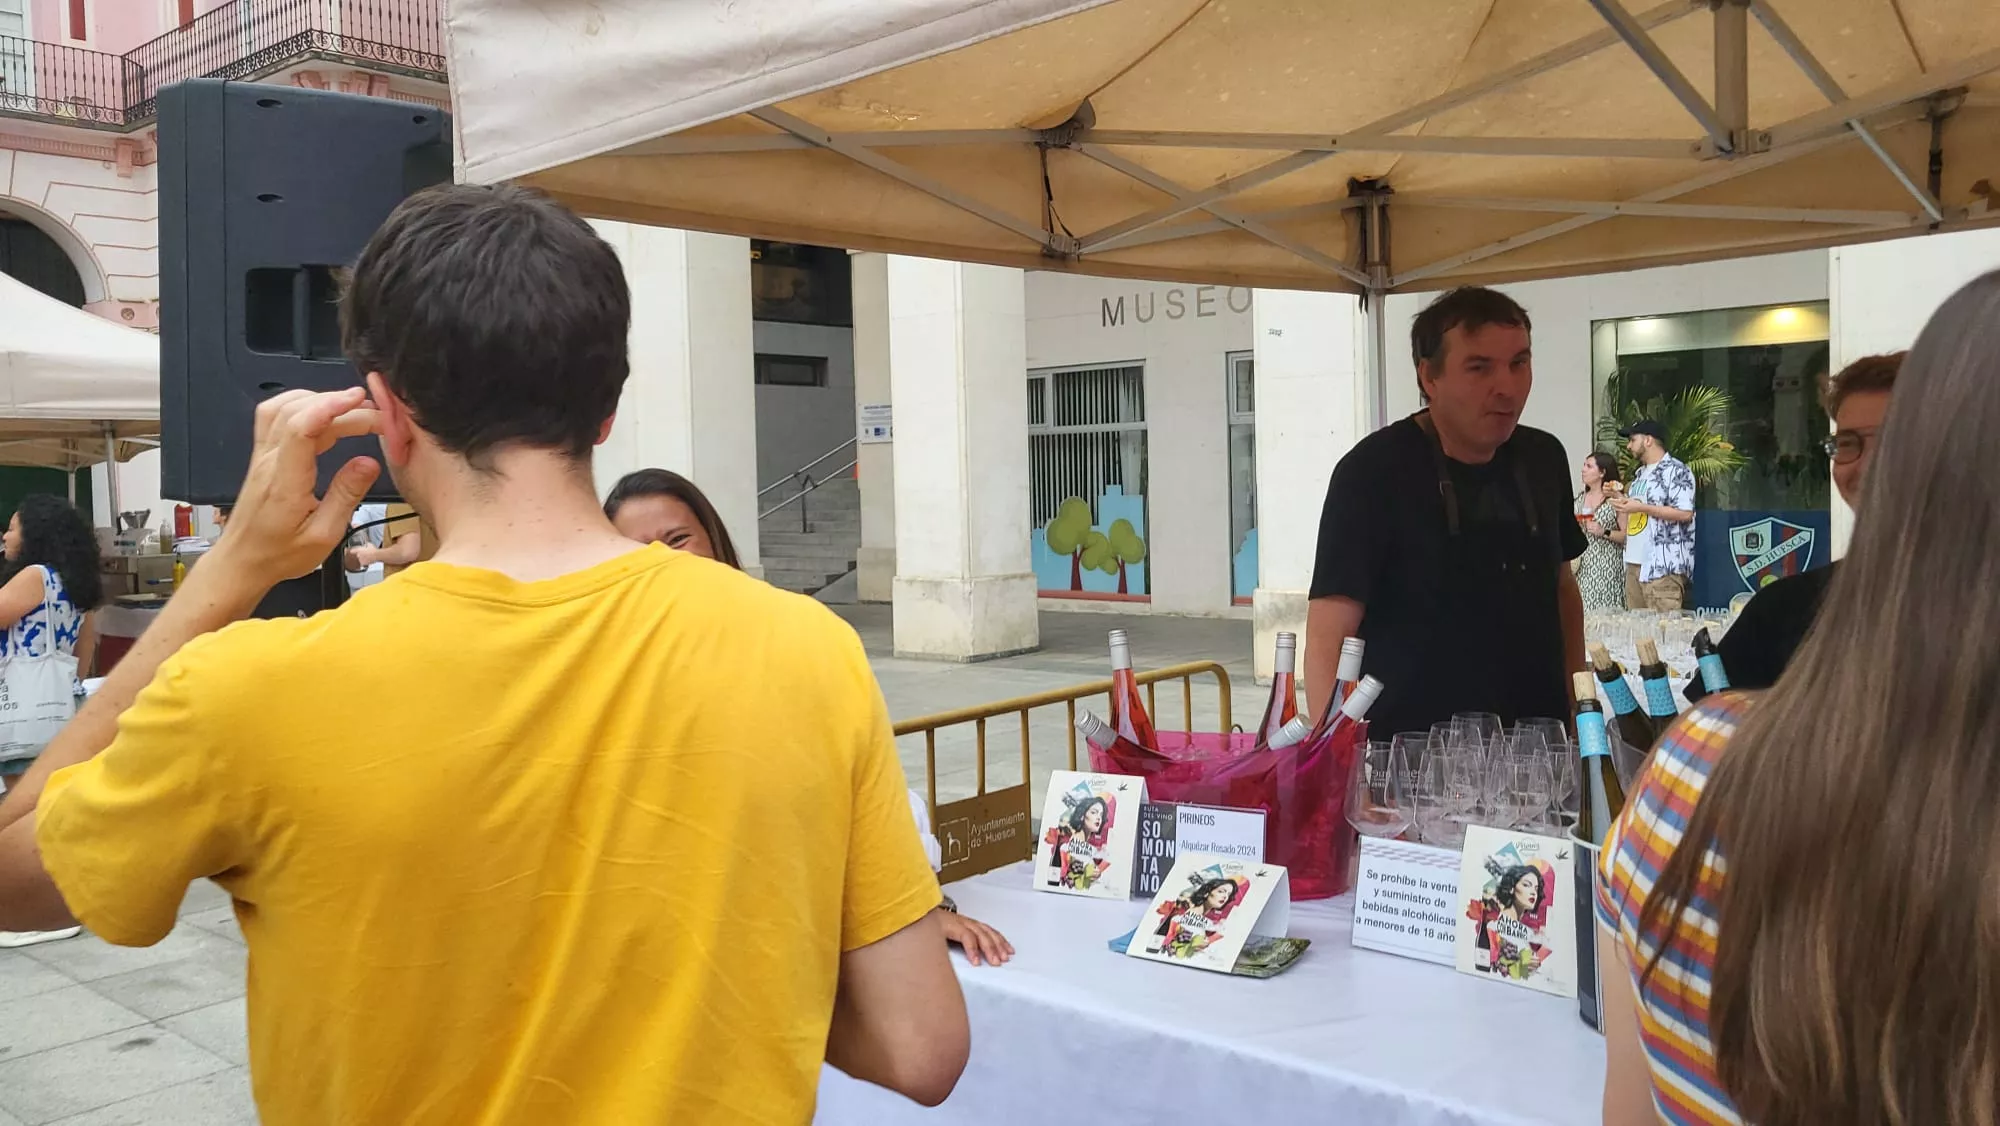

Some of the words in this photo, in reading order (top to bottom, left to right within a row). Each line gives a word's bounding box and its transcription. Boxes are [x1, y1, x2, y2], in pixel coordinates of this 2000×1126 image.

[1101, 285, 1252, 327] MUSEO
[1767, 535, 1806, 561] HUESCA
[971, 811, 1025, 836] Ayuntamiento
[1142, 820, 1161, 838] SO
[1179, 812, 1215, 826] PIRINEOS
[970, 837, 981, 848] de
[985, 827, 1016, 845] Huesca
[1141, 838, 1175, 858] MON
[1211, 842, 1236, 855] Rosado
[1237, 845, 1256, 856] 2024
[1141, 856, 1159, 874] TA
[1140, 873, 1160, 893] NO
[1366, 869, 1378, 880] Se
[1419, 877, 1428, 889] la
[1430, 882, 1457, 894] venta
[1373, 887, 1379, 897] y
[1381, 889, 1431, 905] suministro
[1434, 897, 1446, 908] de
[1362, 899, 1399, 915] bebidas
[1401, 908, 1457, 927] alcohólicas
[1498, 913, 1528, 934] AHORA
[1355, 916, 1362, 924] a
[1364, 918, 1405, 933] menores
[1407, 924, 1420, 936] de
[1423, 927, 1434, 938] 18
[1436, 931, 1455, 942] año
